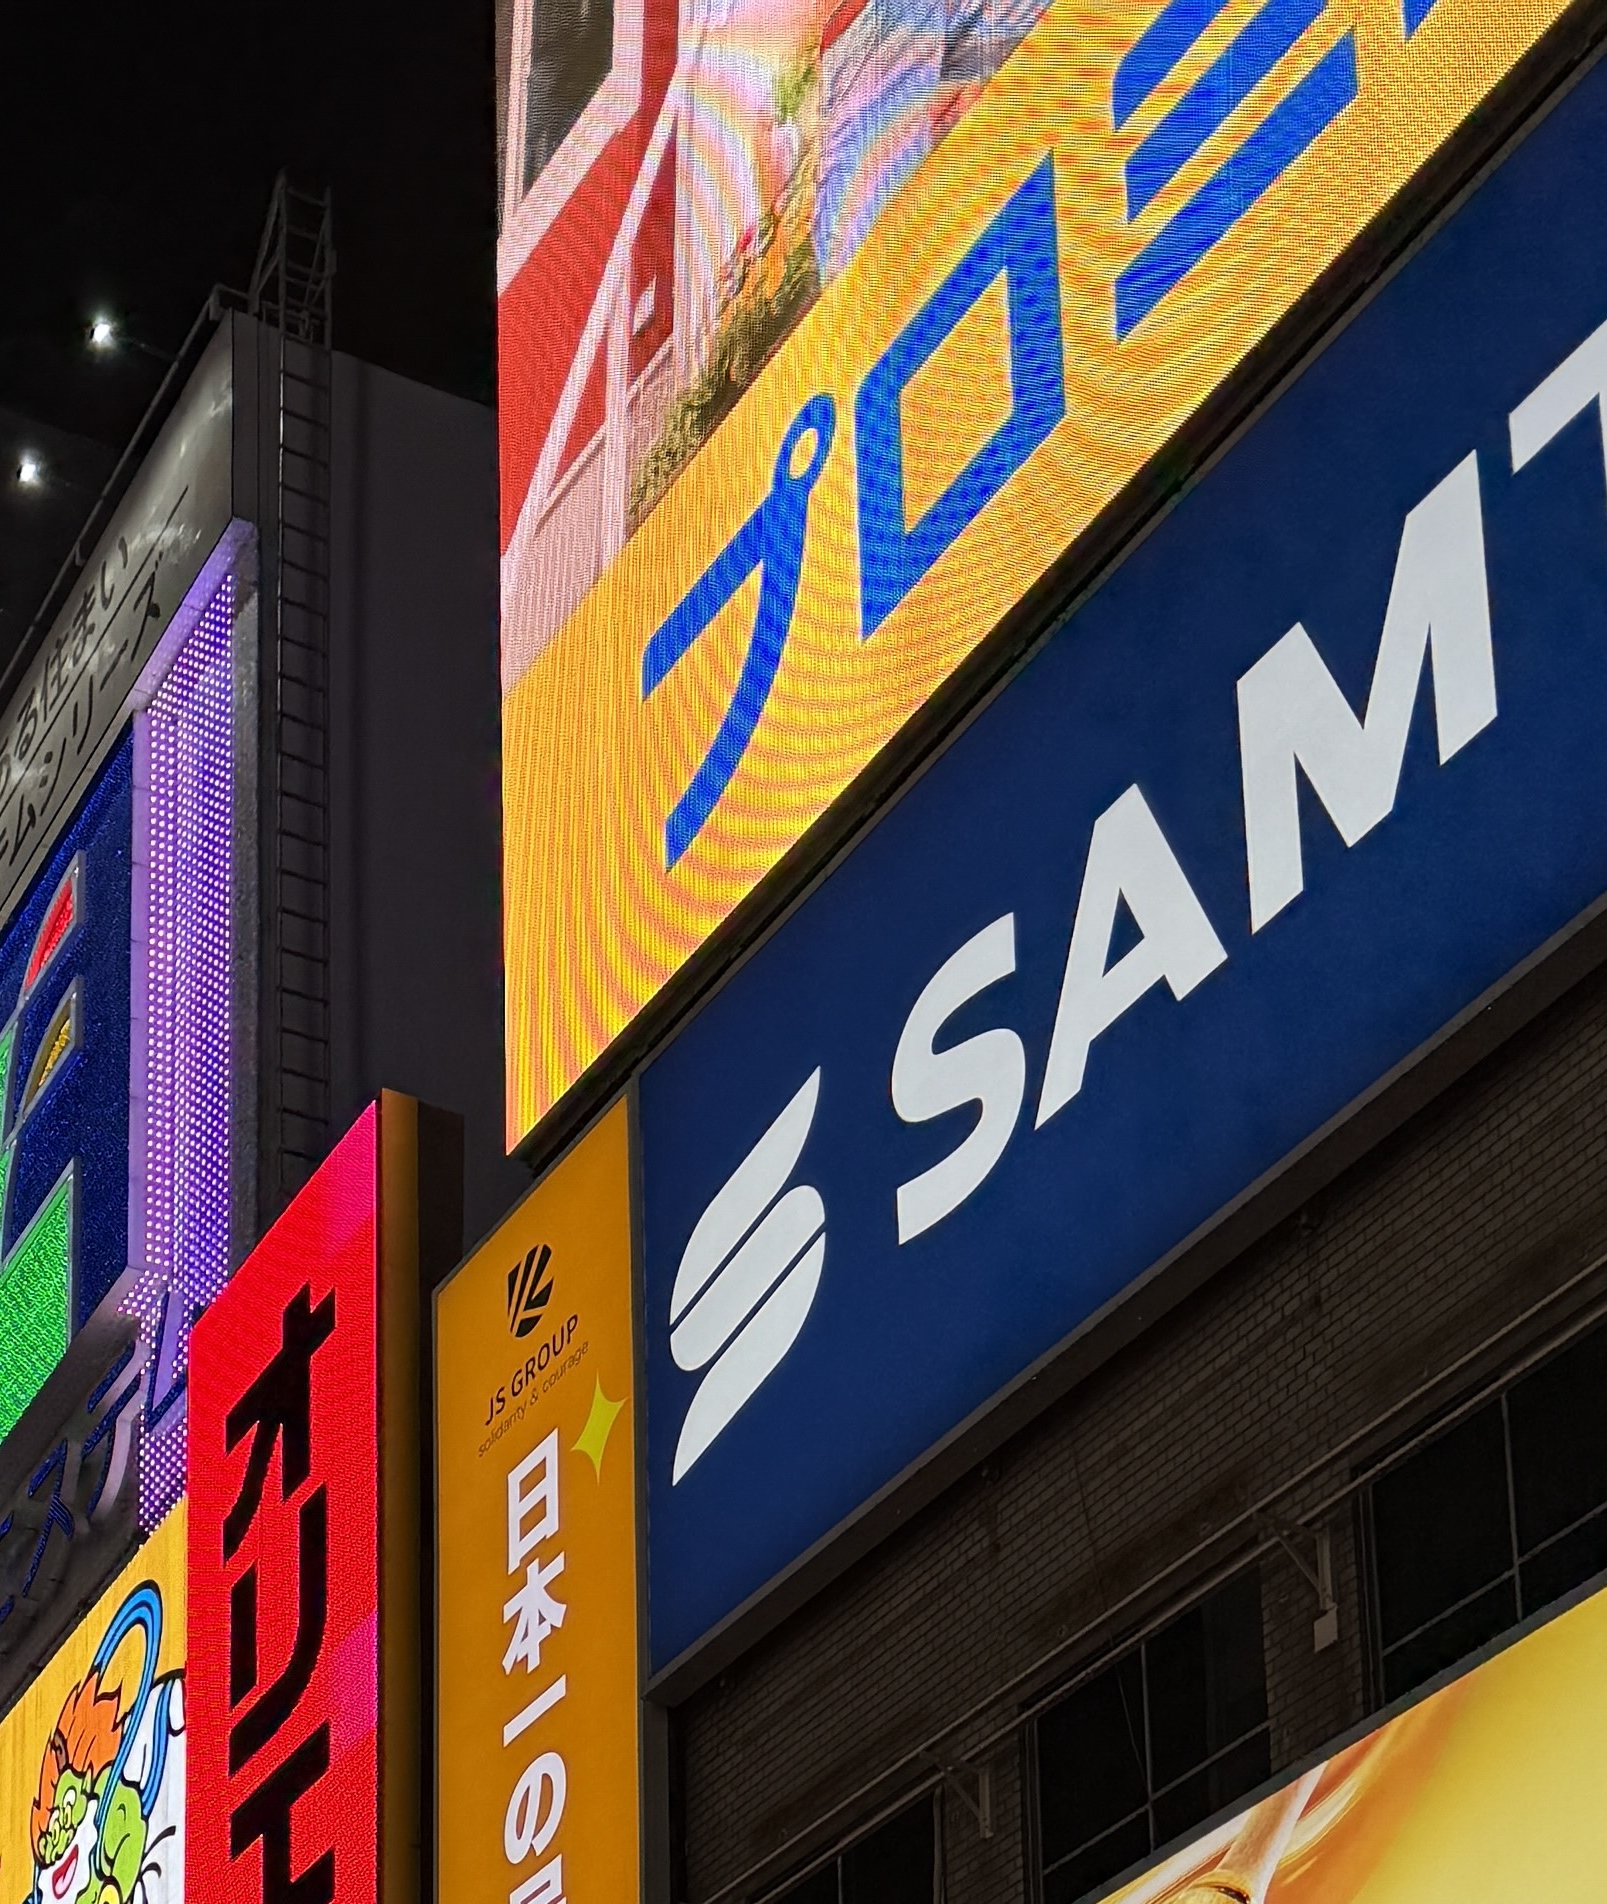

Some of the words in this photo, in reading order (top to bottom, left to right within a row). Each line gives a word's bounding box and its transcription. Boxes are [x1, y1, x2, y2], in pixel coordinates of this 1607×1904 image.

[642, 0, 1427, 872] プロミ
[477, 1404, 525, 1459] solidarity
[529, 1389, 540, 1407] &
[542, 1340, 590, 1393] courage
[484, 1384, 507, 1427] JS
[511, 1313, 580, 1399] GROUP
